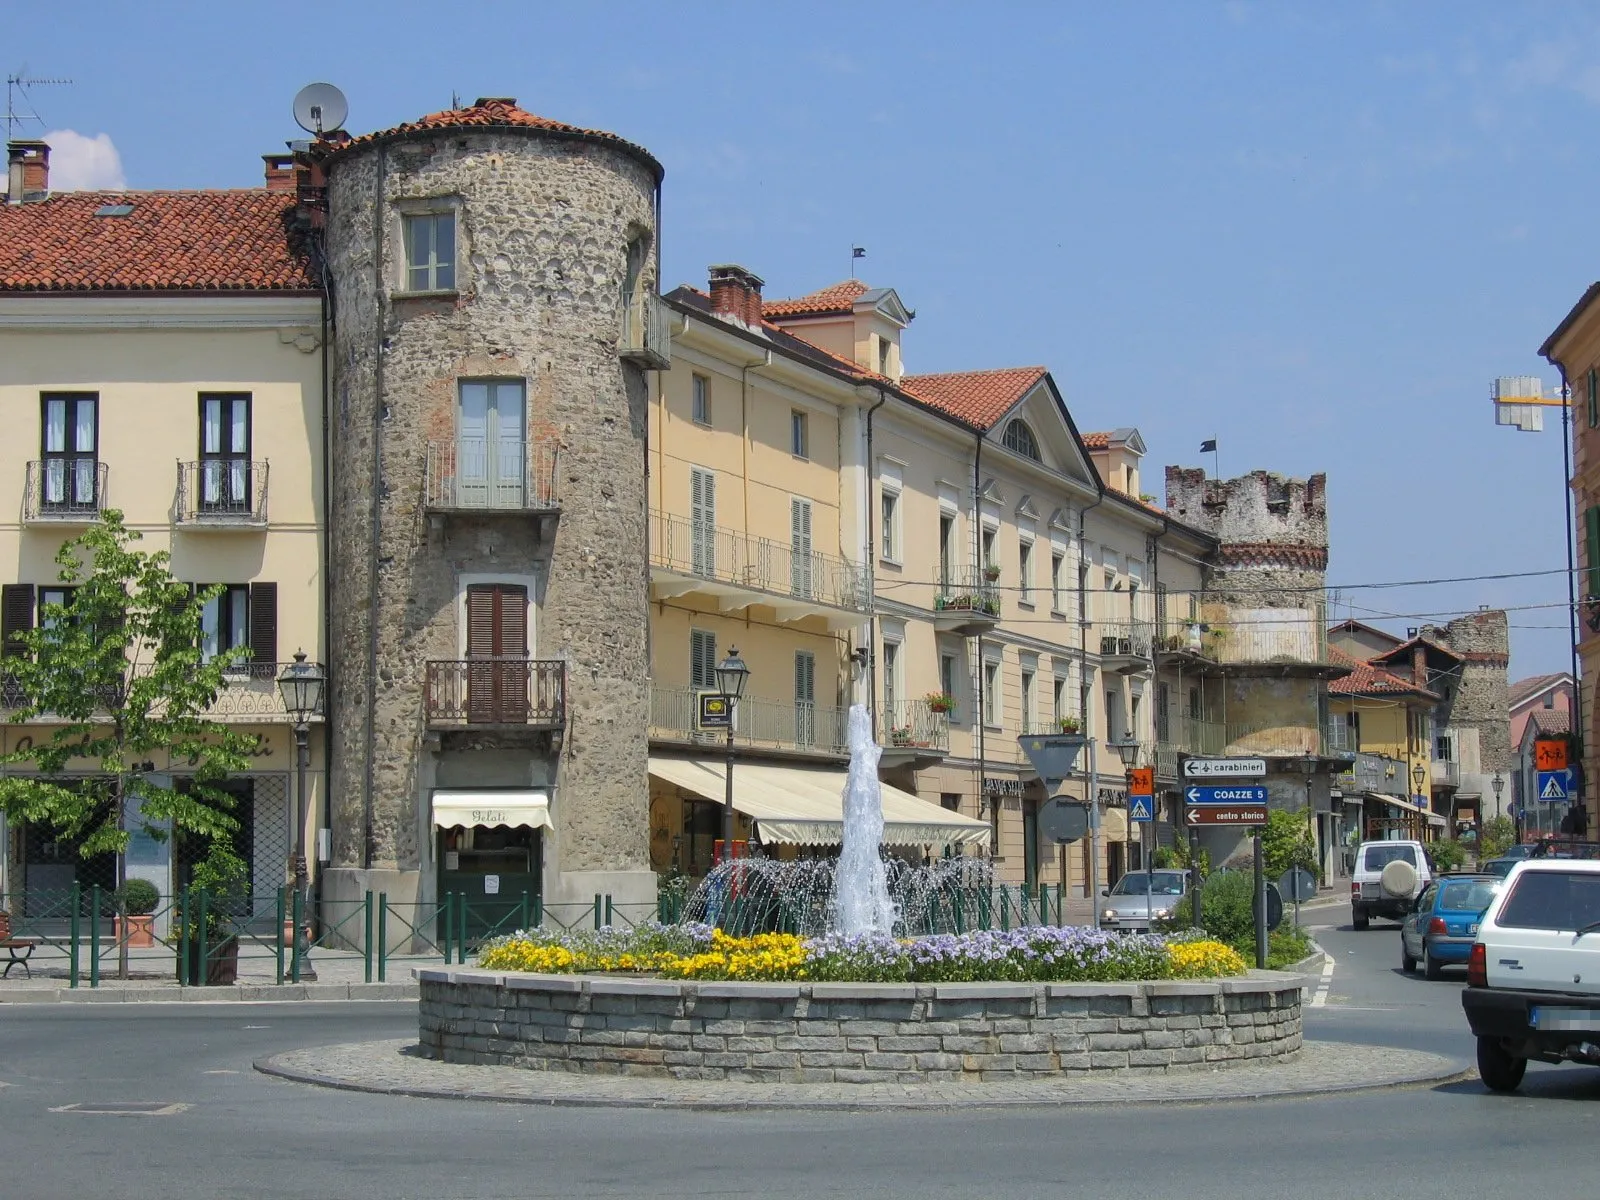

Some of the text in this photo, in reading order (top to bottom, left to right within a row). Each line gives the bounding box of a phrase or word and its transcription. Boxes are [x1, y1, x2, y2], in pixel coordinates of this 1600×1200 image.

[1214, 763, 1263, 771] carabinieri
[1214, 790, 1264, 799] COAZZE 5
[472, 810, 507, 822] Gelati
[1216, 811, 1265, 820] centro storico
